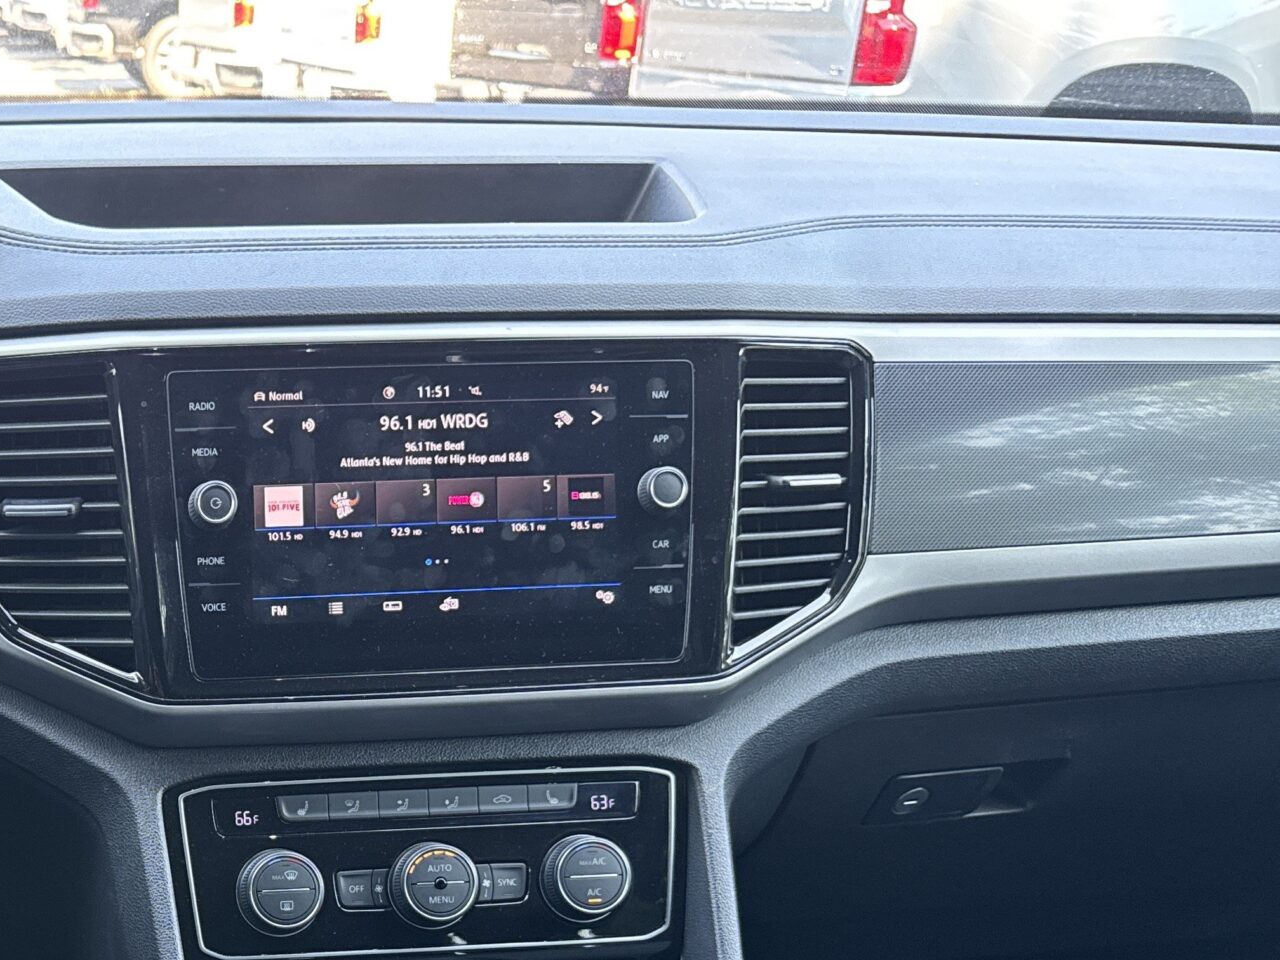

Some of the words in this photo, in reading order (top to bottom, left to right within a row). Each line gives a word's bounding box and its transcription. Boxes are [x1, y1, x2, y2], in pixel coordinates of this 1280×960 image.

[269, 390, 303, 401] Normal
[417, 386, 450, 398] 11:51
[652, 390, 669, 399] NAV
[189, 402, 215, 411] RADIO
[379, 415, 413, 431] 96.1
[418, 419, 437, 430] HD1
[440, 413, 488, 429] WRDG
[653, 434, 669, 443] APP
[405, 443, 422, 452] 96.1
[425, 442, 442, 451] The
[445, 441, 464, 451] Beat
[192, 448, 218, 457] MEDIA
[340, 457, 380, 467] Atlanta's
[383, 457, 403, 466] New
[405, 456, 432, 466] Home
[434, 455, 448, 464] for
[450, 455, 466, 466] Hip
[469, 453, 487, 465] Hop
[489, 453, 507, 463] and
[509, 452, 529, 462] R&B
[422, 484, 431, 496] 3
[543, 479, 551, 492] 5
[450, 525, 470, 534] 96.1
[511, 523, 535, 532] 106.1
[570, 521, 590, 530] 98.5
[268, 531, 291, 541] 101.5
[329, 529, 349, 539] 94.9
[391, 527, 411, 537] 92.9
[652, 540, 669, 549] CAR
[197, 556, 225, 565] PHONE
[649, 585, 673, 594] MENU
[201, 603, 226, 612] VOICE
[271, 605, 287, 616] FM
[427, 864, 452, 873] AUTO
[497, 878, 517, 887] SYNC
[348, 884, 364, 893] OFF
[587, 887, 602, 896] A/C
[429, 895, 455, 904] MENU
